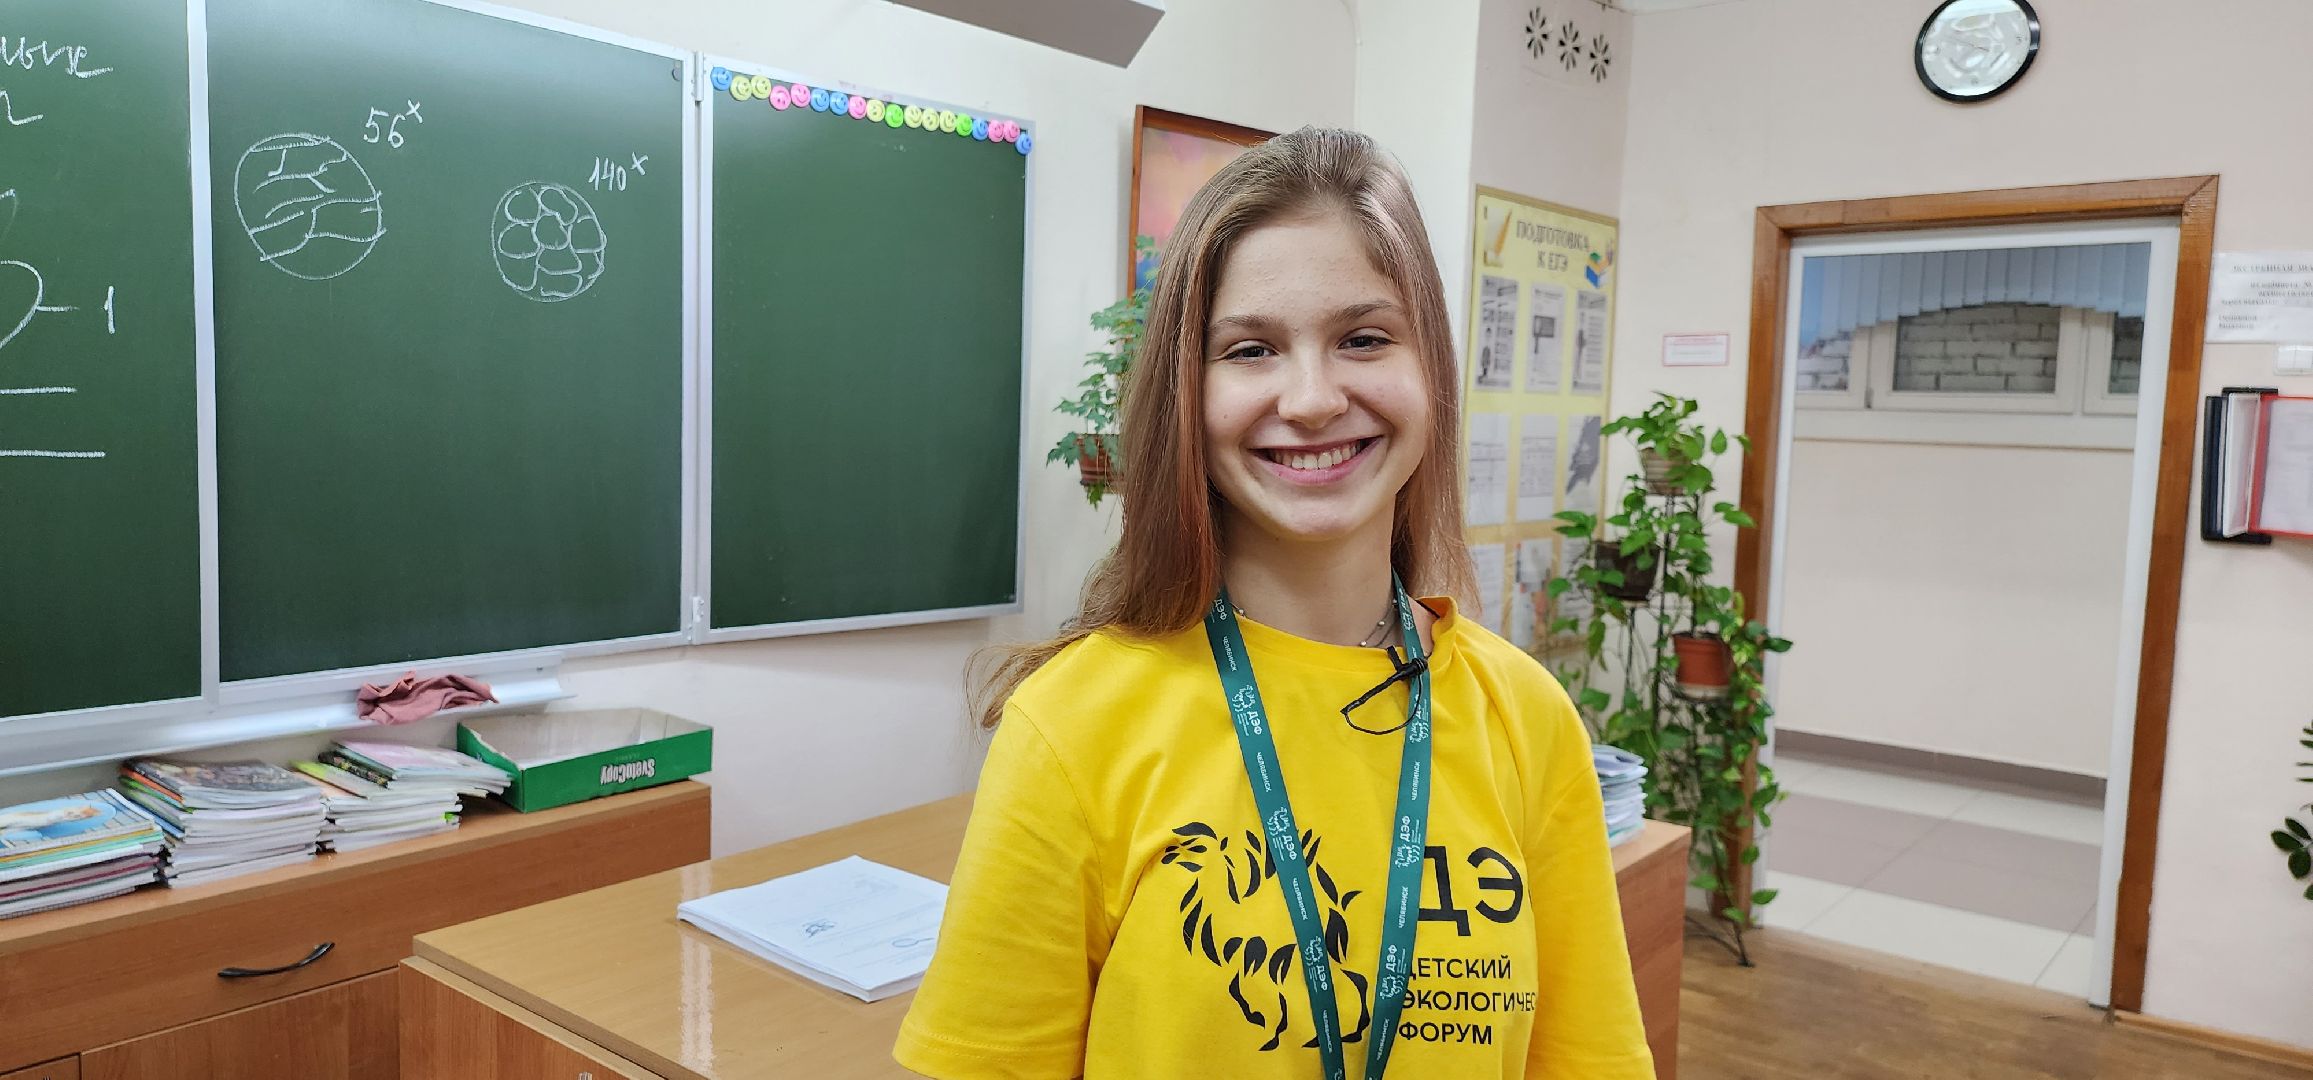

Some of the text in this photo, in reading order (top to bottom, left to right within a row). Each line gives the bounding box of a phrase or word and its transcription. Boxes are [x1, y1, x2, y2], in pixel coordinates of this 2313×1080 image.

[1223, 635, 1237, 672] ЧЕЛЯБИНСК
[1247, 710, 1262, 735] ДЭФ
[600, 758, 656, 785] SvetoCopy
[1257, 751, 1272, 792] ЧЕЛЯБИНСК
[1411, 761, 1420, 801] ЧЕЛЯБИНСК
[1400, 815, 1411, 842] ДЭФ
[1283, 835, 1298, 860] ДЭФ
[1293, 877, 1308, 920] ЧЕЛЯБИНСК
[1417, 846, 1524, 936] ДЭ
[1398, 886, 1408, 928] ЧЕЛЯБИНСК
[1386, 944, 1397, 973] ДЭФ
[1316, 964, 1328, 991] ДЭФ
[1398, 1021, 1492, 1045] ФОРУМ
